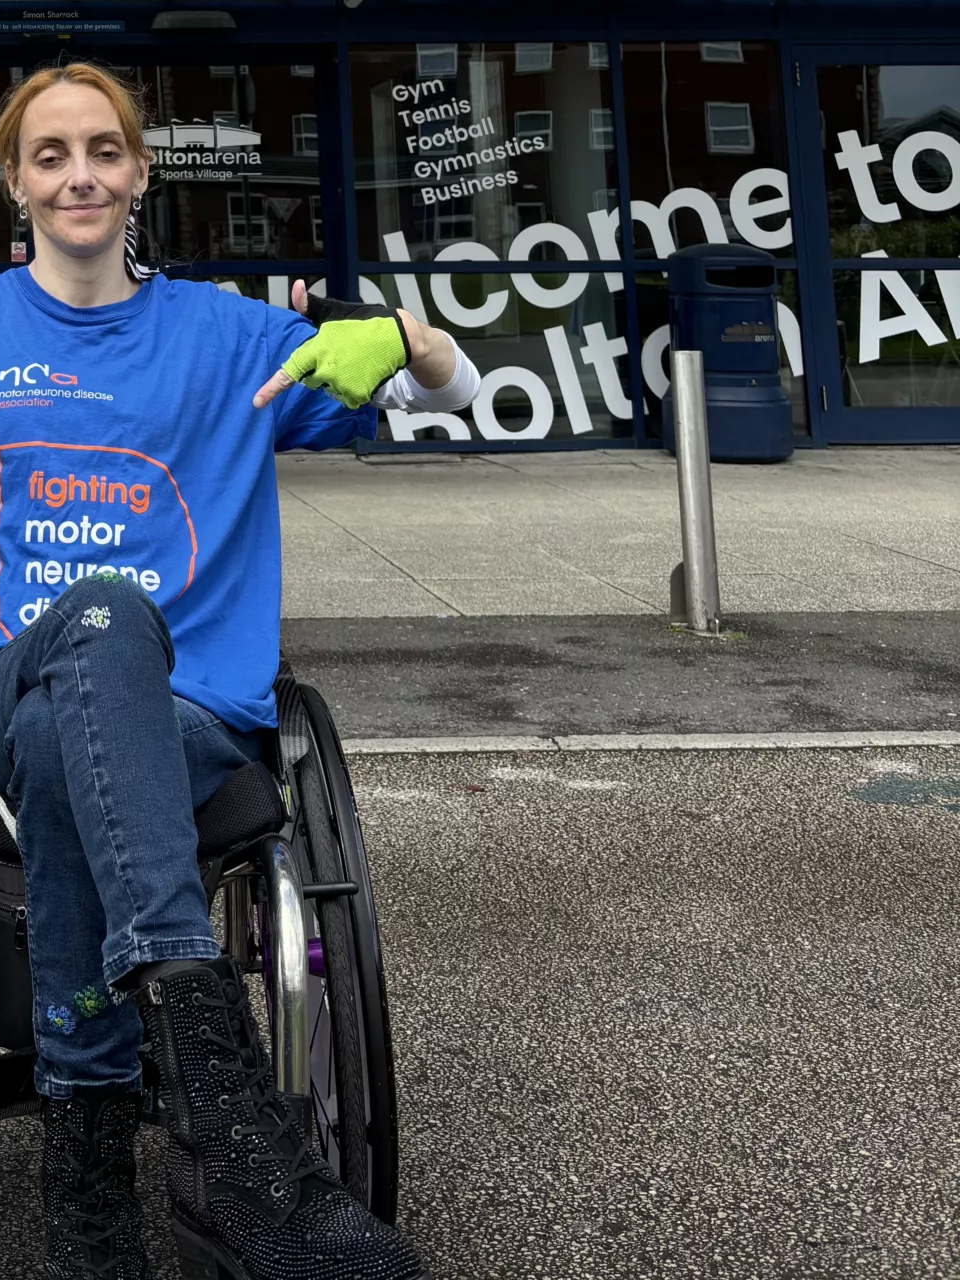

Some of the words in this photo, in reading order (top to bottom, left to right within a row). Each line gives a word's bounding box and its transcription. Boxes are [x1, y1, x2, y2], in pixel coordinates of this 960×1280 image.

[22, 10, 45, 19] Simon
[95, 23, 121, 31] premises
[392, 79, 445, 104] Gym
[398, 97, 471, 127] Tennis
[406, 117, 495, 154] Football
[414, 136, 545, 180] Gymnastics
[159, 169, 194, 181] Sports
[196, 169, 233, 181] Village
[421, 170, 518, 205] Business
[834, 129, 960, 223] to
[27, 388, 71, 398] neurone
[72, 389, 114, 401] disease
[29, 471, 151, 514] fighting
[25, 515, 126, 546] motor
